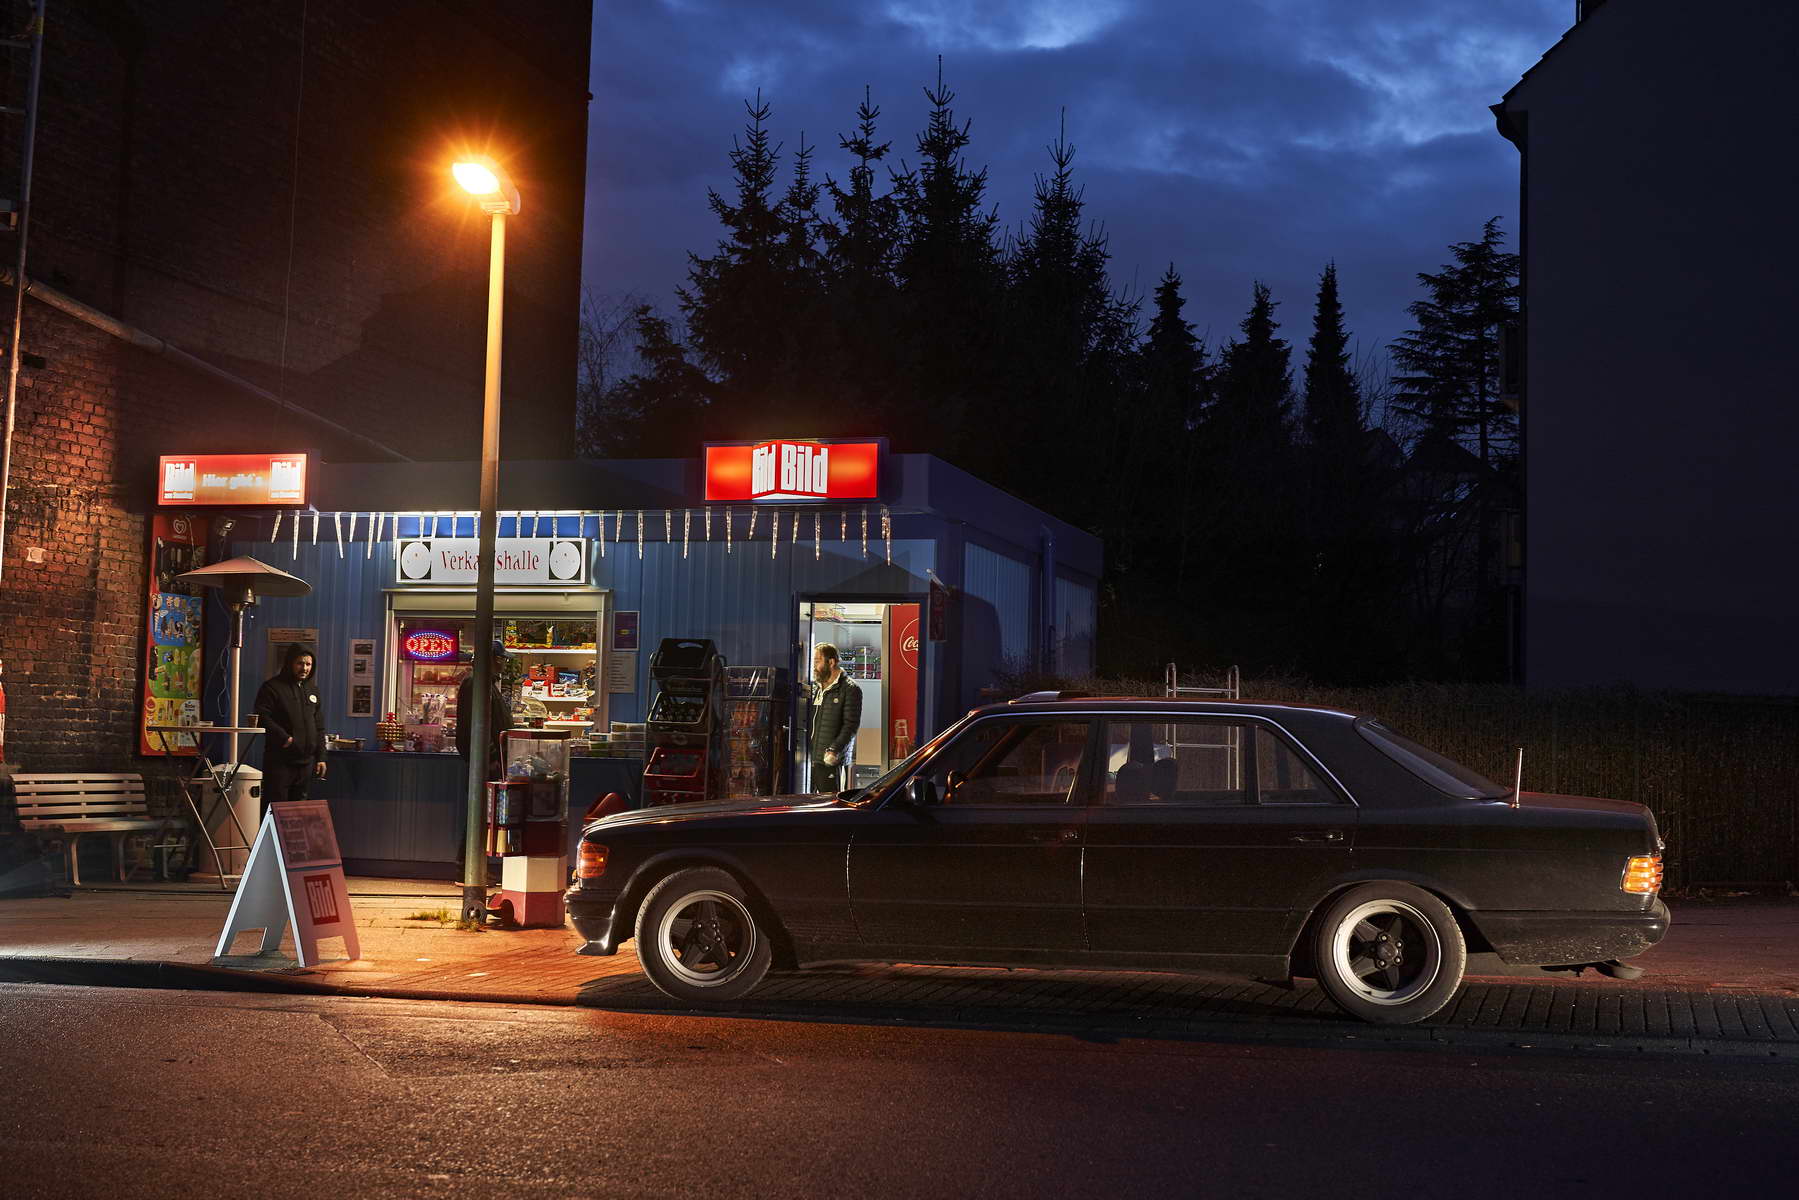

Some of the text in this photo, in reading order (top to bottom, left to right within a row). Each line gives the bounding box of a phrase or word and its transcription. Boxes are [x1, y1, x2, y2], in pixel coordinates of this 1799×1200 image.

[781, 443, 828, 493] Bild
[441, 550, 539, 570] Verkashalle
[406, 638, 453, 652] OPEN
[307, 879, 336, 918] Bild
